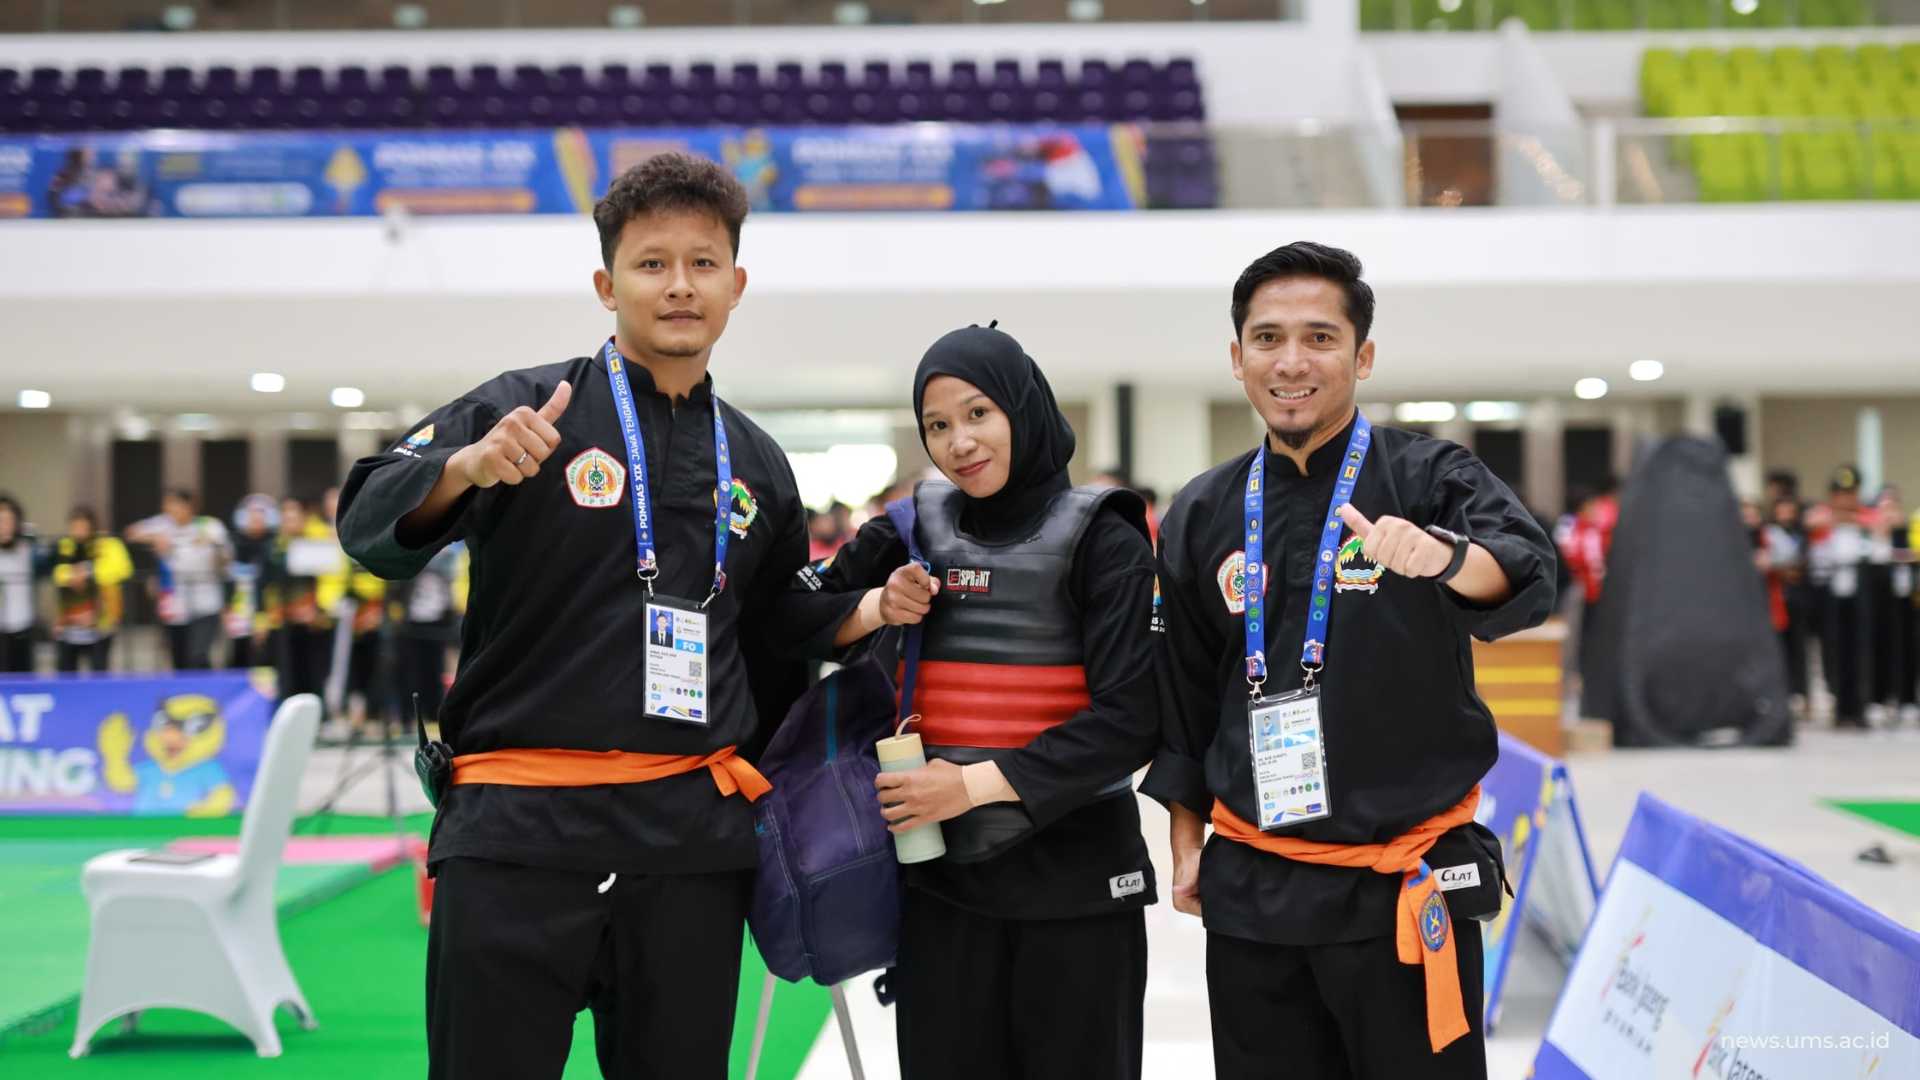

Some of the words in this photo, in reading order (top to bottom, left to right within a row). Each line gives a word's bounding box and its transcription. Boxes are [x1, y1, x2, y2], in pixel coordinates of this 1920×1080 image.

[615, 373, 627, 397] 2025
[621, 398, 635, 433] TENGAH
[628, 434, 640, 460] JAWA
[633, 463, 643, 482] XIX
[635, 484, 648, 529] POMNAS
[1441, 869, 1473, 882] CLAT
